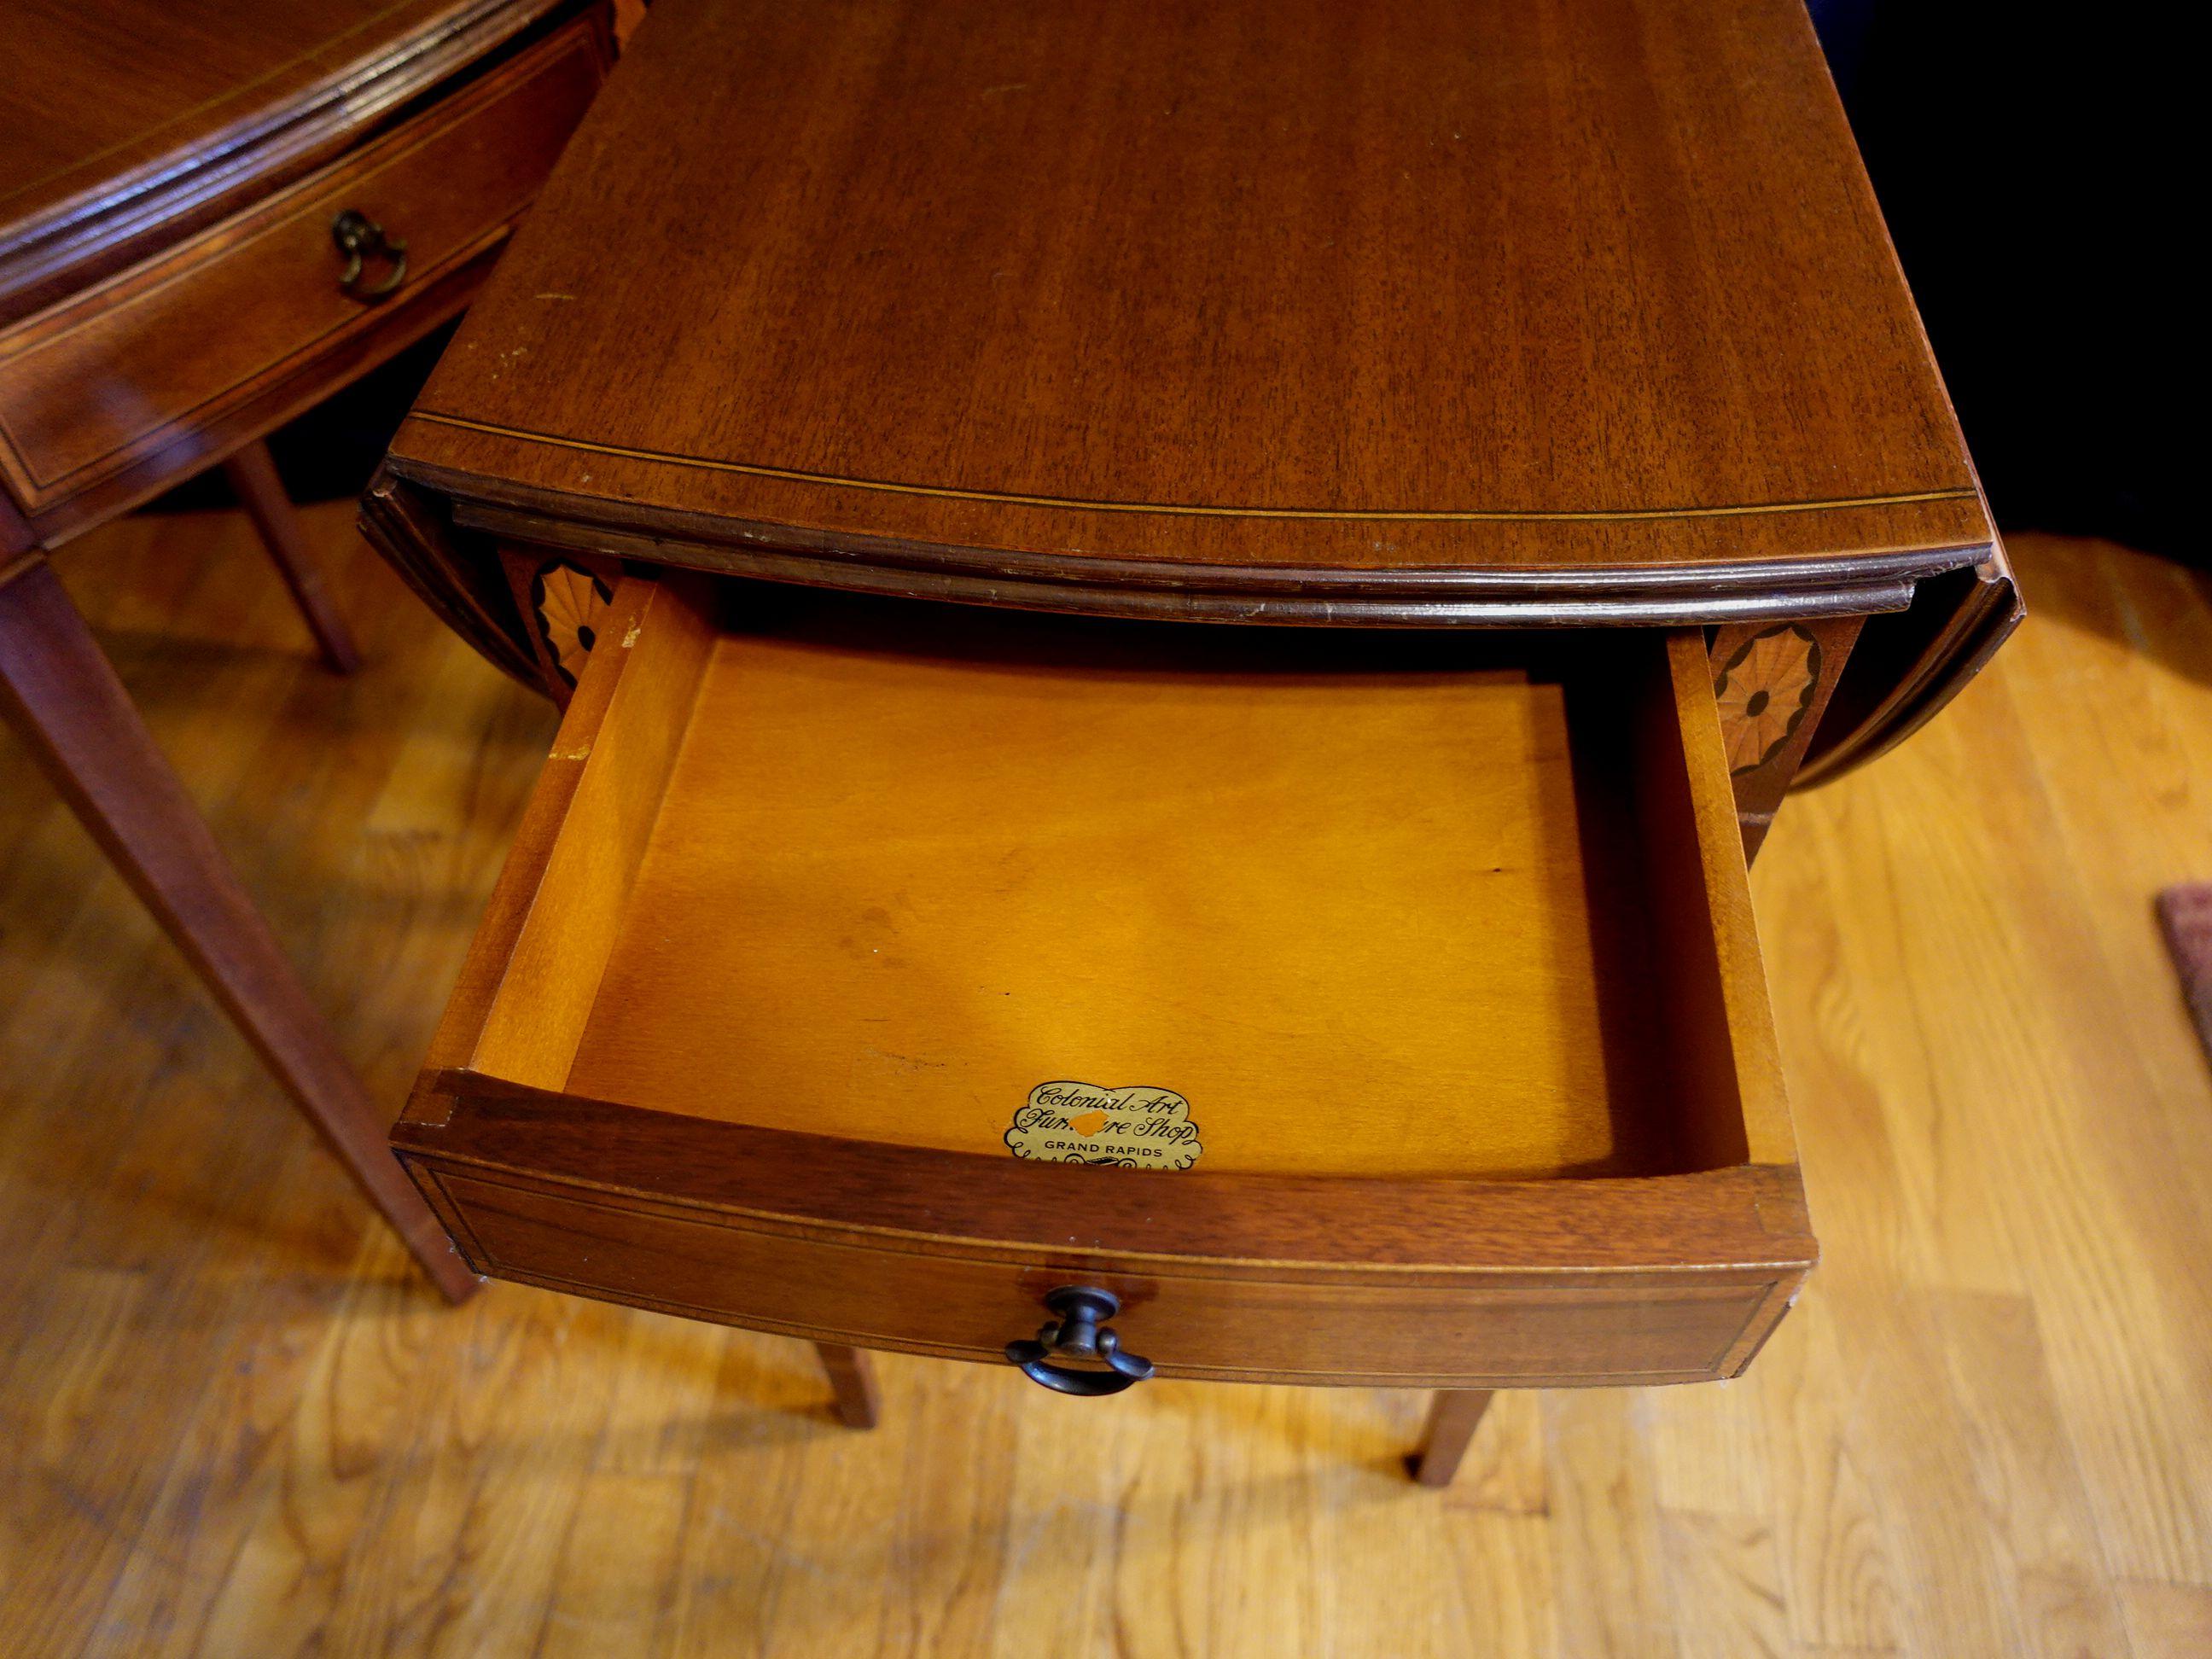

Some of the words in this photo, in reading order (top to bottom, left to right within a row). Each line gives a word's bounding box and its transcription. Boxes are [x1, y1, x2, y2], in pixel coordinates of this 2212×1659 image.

[1036, 1086, 1135, 1111] Colonial
[1129, 1095, 1185, 1115] Art
[1132, 1117, 1194, 1144] Shop
[1044, 1140, 1100, 1153] GRAND
[1105, 1145, 1163, 1158] RAPIDS
